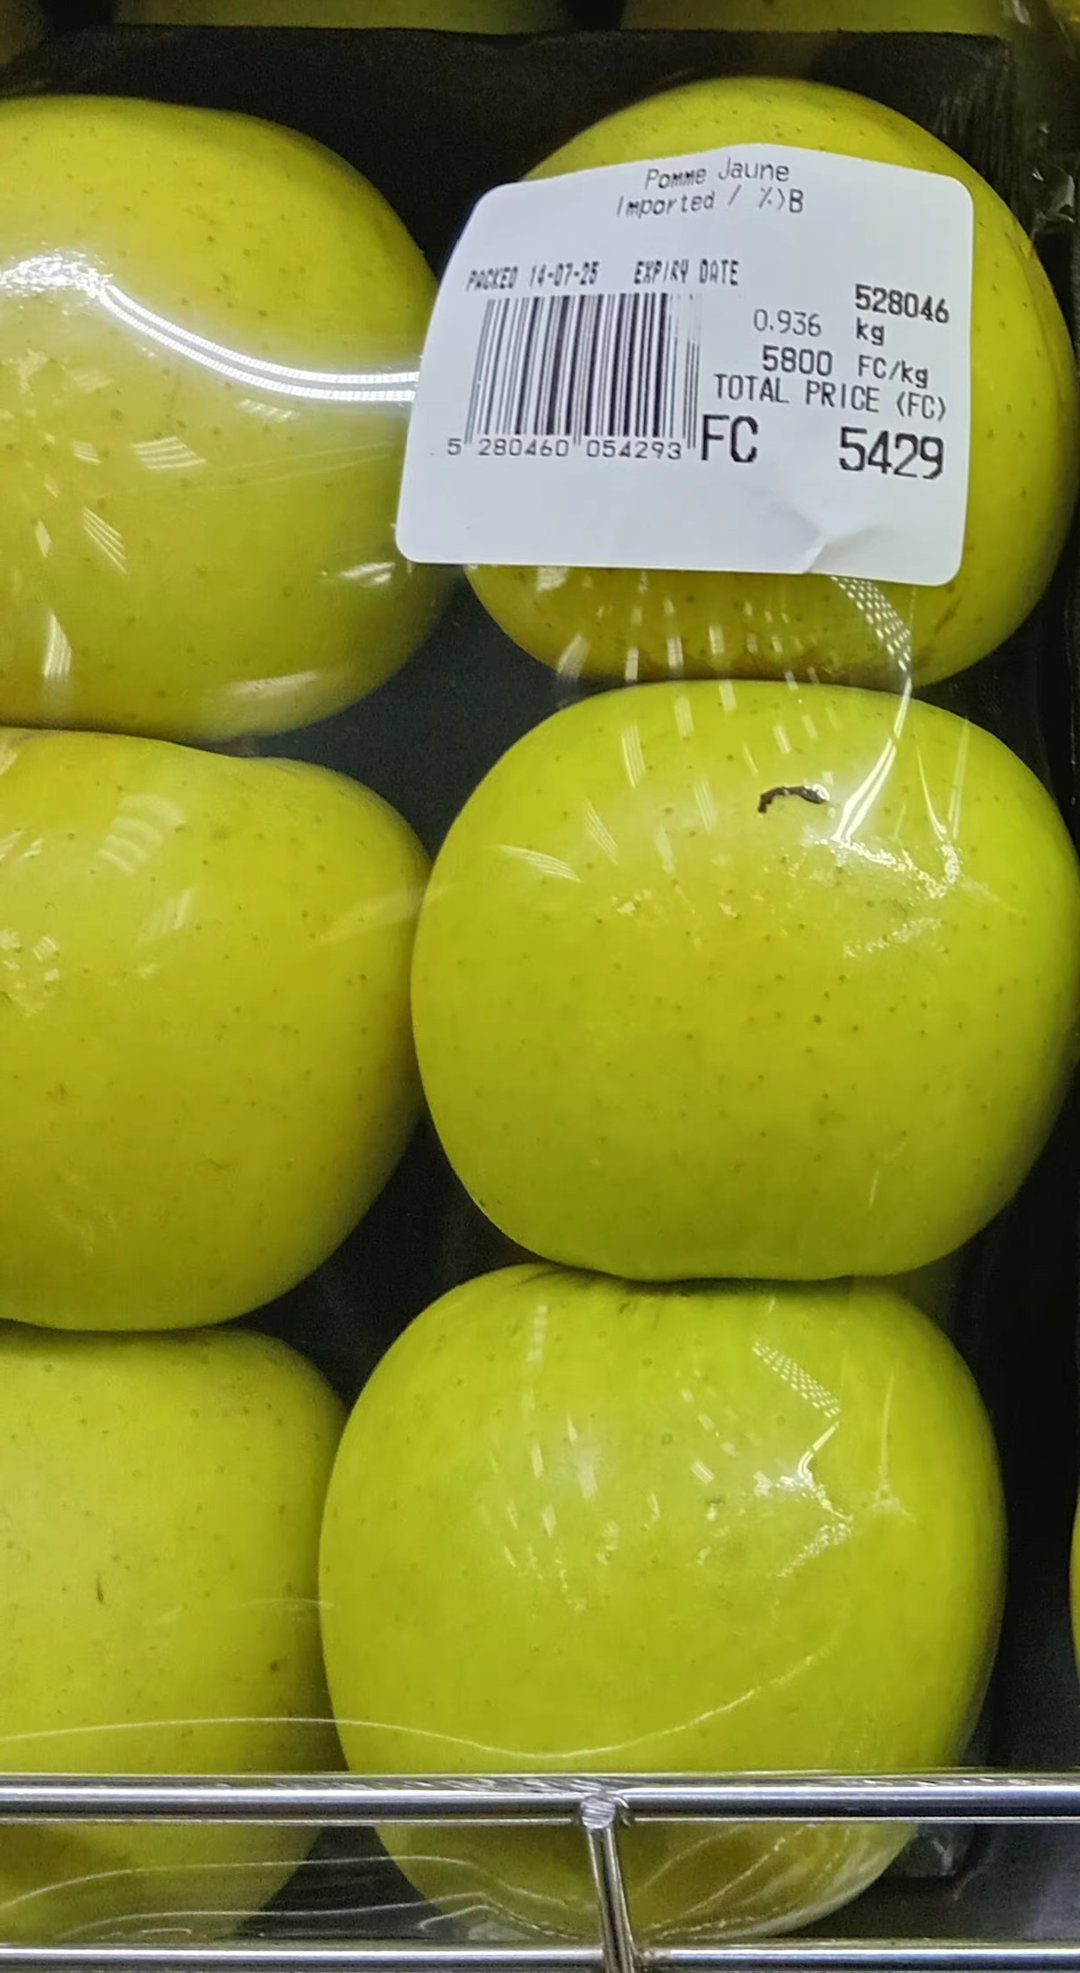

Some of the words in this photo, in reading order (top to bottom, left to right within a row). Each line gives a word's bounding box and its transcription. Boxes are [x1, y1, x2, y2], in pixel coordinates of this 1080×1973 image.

[644, 167, 707, 190] Pomme
[718, 156, 790, 182] Jaune
[616, 191, 716, 219] Imported
[728, 184, 742, 206] /
[466, 266, 519, 291] PACKED
[529, 261, 600, 288] 14-07-25
[633, 258, 690, 285] EXPIRY
[699, 258, 740, 286] DATE
[855, 283, 951, 324] 528046
[753, 308, 823, 337] 0.936
[856, 318, 885, 347] kg
[762, 344, 834, 377] 5800
[857, 354, 929, 389] FC/kg
[714, 374, 790, 404] TOTAL
[805, 380, 880, 413] PRICE
[896, 391, 947, 421] (FC)
[447, 437, 463, 456] 5
[478, 438, 569, 458] 280460
[586, 439, 682, 461] 054293
[700, 414, 759, 464] FC
[838, 426, 945, 480] 5429
